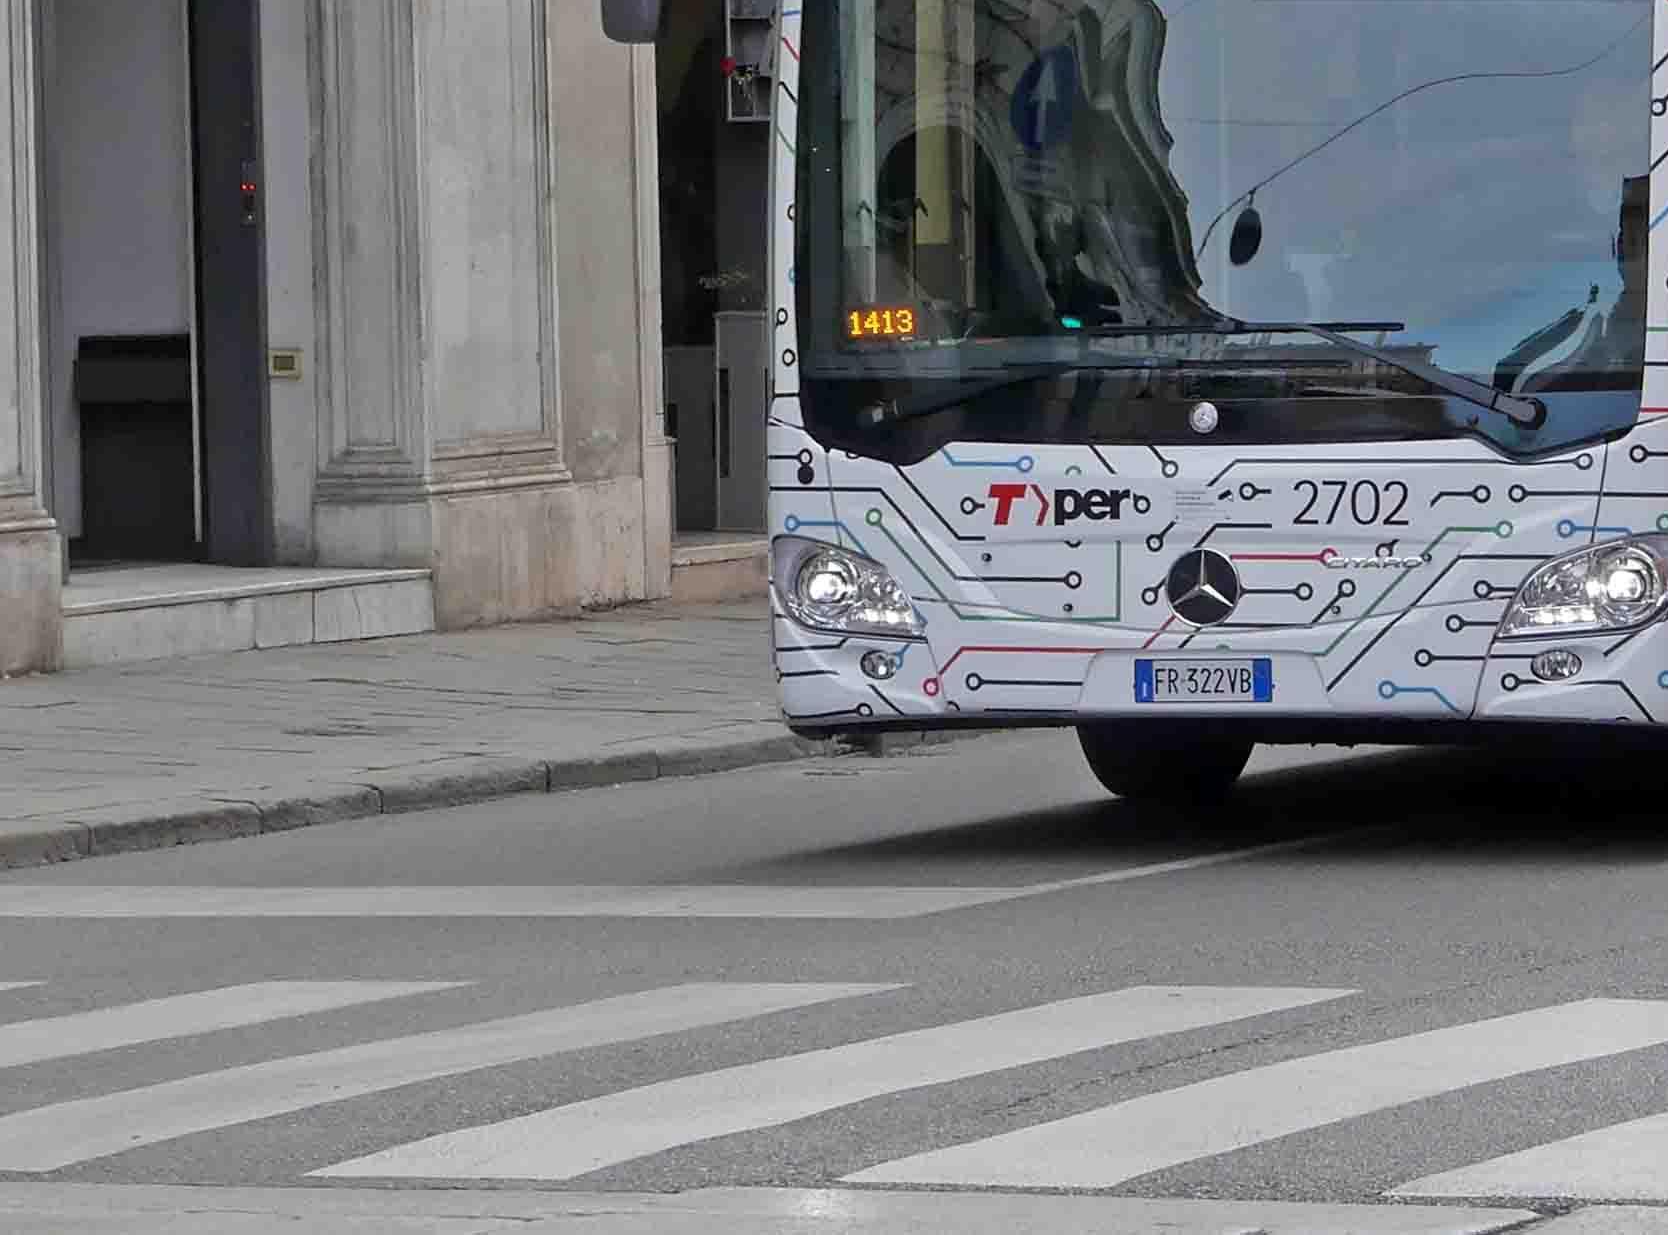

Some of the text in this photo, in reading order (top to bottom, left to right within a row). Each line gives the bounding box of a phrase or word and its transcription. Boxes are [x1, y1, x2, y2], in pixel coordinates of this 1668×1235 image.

[849, 309, 913, 336] 1413
[1291, 479, 1410, 526] 2702
[1154, 667, 1179, 695] FR
[1186, 667, 1252, 695] 322VB
